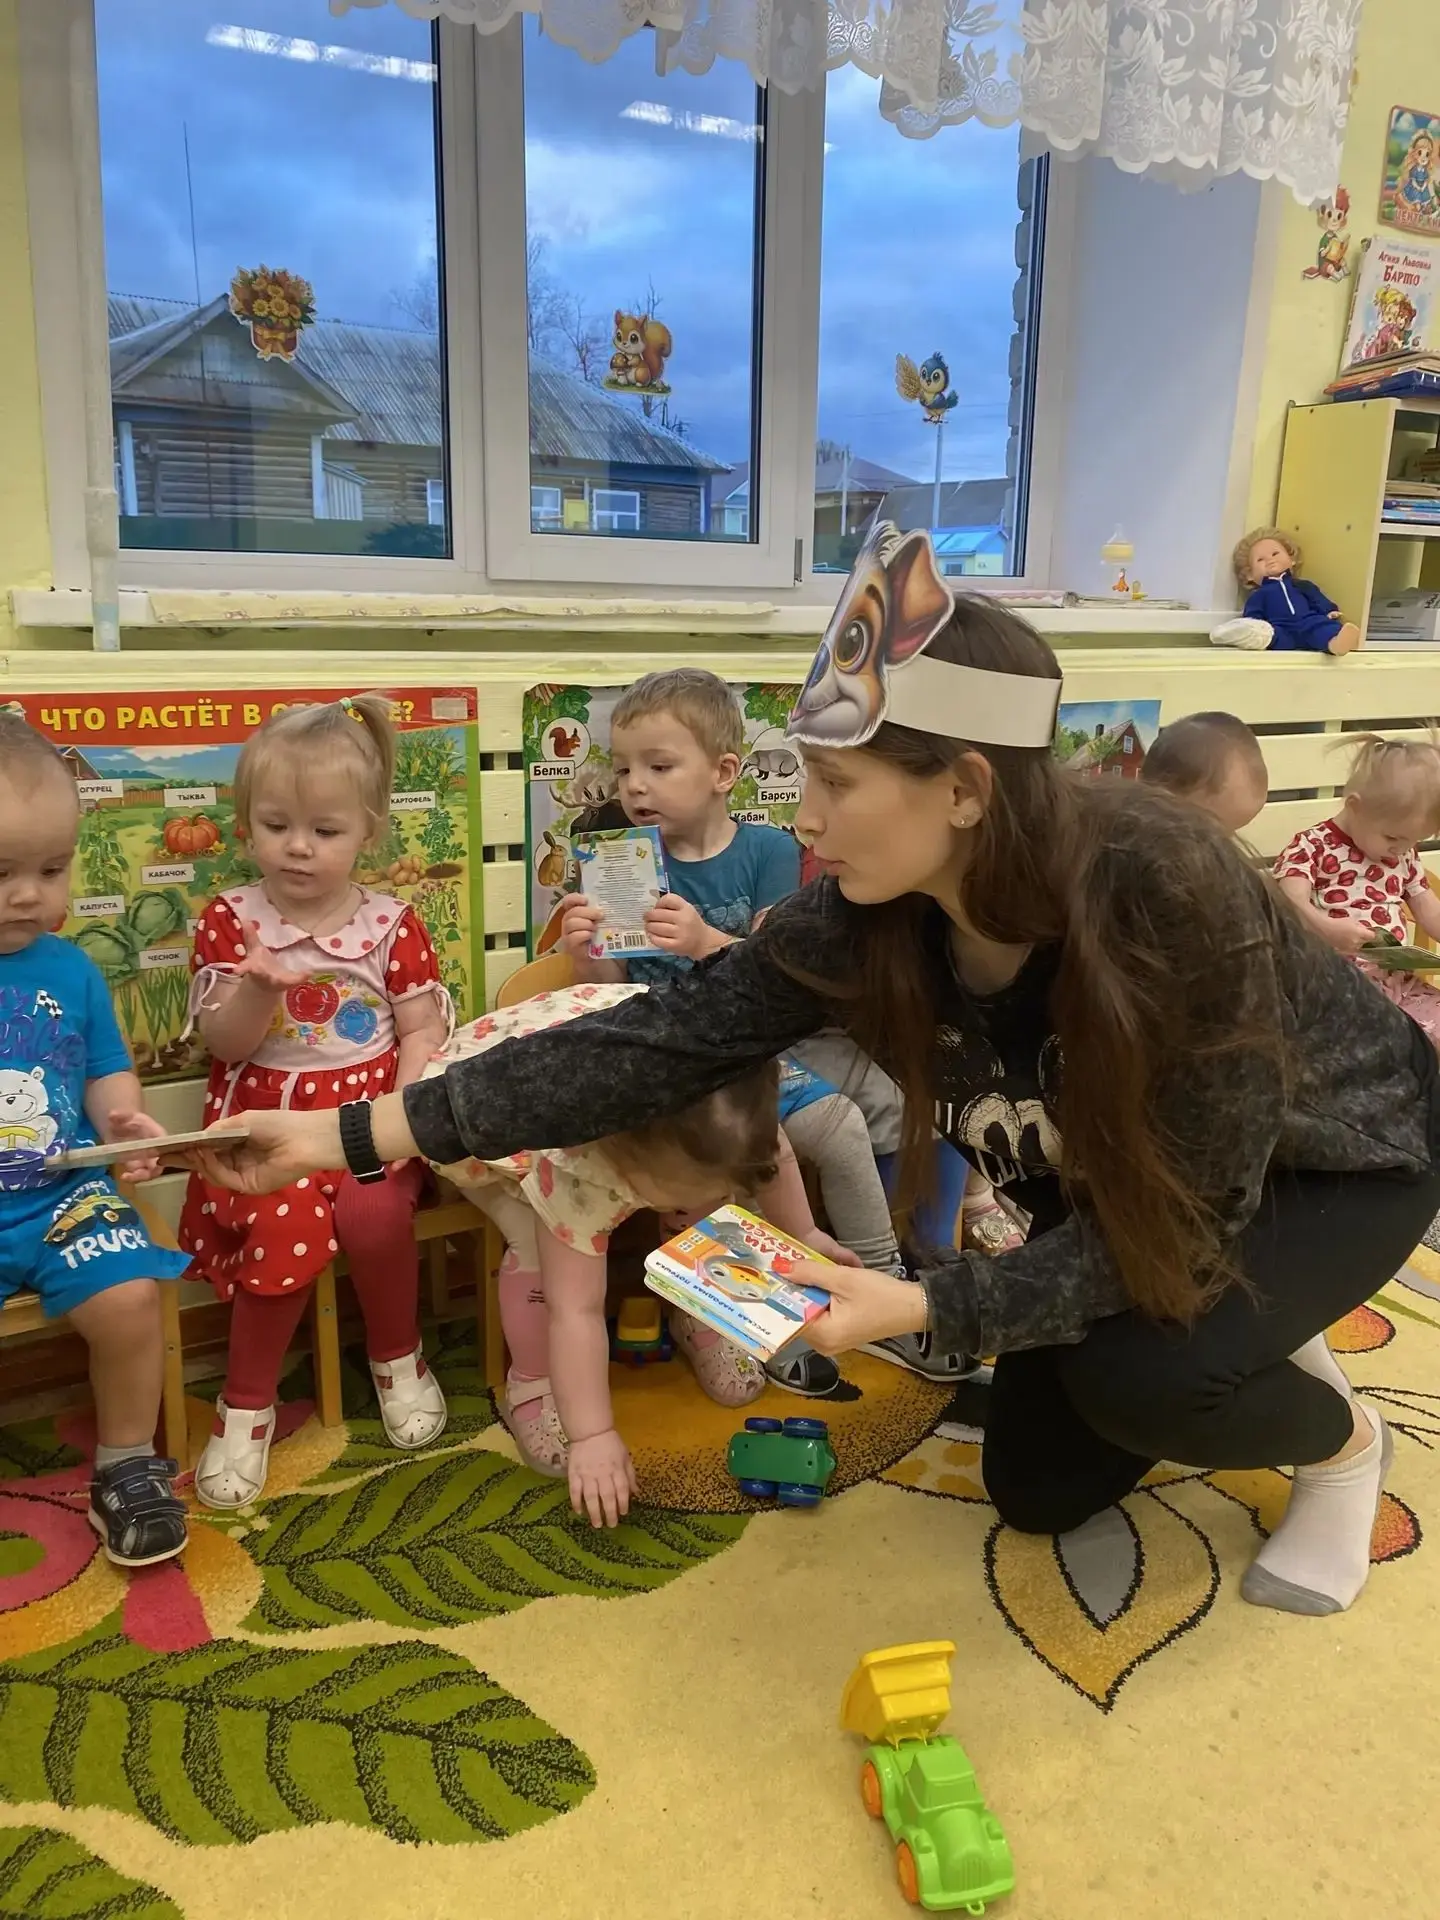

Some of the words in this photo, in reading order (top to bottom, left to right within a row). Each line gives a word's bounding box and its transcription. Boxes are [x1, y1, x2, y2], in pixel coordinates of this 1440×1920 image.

[40, 707, 106, 731] ЧТО
[116, 698, 233, 729] РАСТЁТ
[243, 703, 262, 726] В
[533, 764, 570, 777] Белка
[79, 785, 113, 794] ОГУРЕЦ
[177, 793, 206, 801] ТЫКВА
[390, 796, 432, 805] КАРТОФЕЛЬ
[760, 789, 797, 802] Барсук
[148, 869, 187, 879] КАБАЧОК
[79, 901, 119, 912] КАПУСТА
[147, 952, 181, 961] ЧЕСНОК
[59, 1228, 149, 1270] TRUCK
[693, 1284, 735, 1313] НАРОДНАЯ
